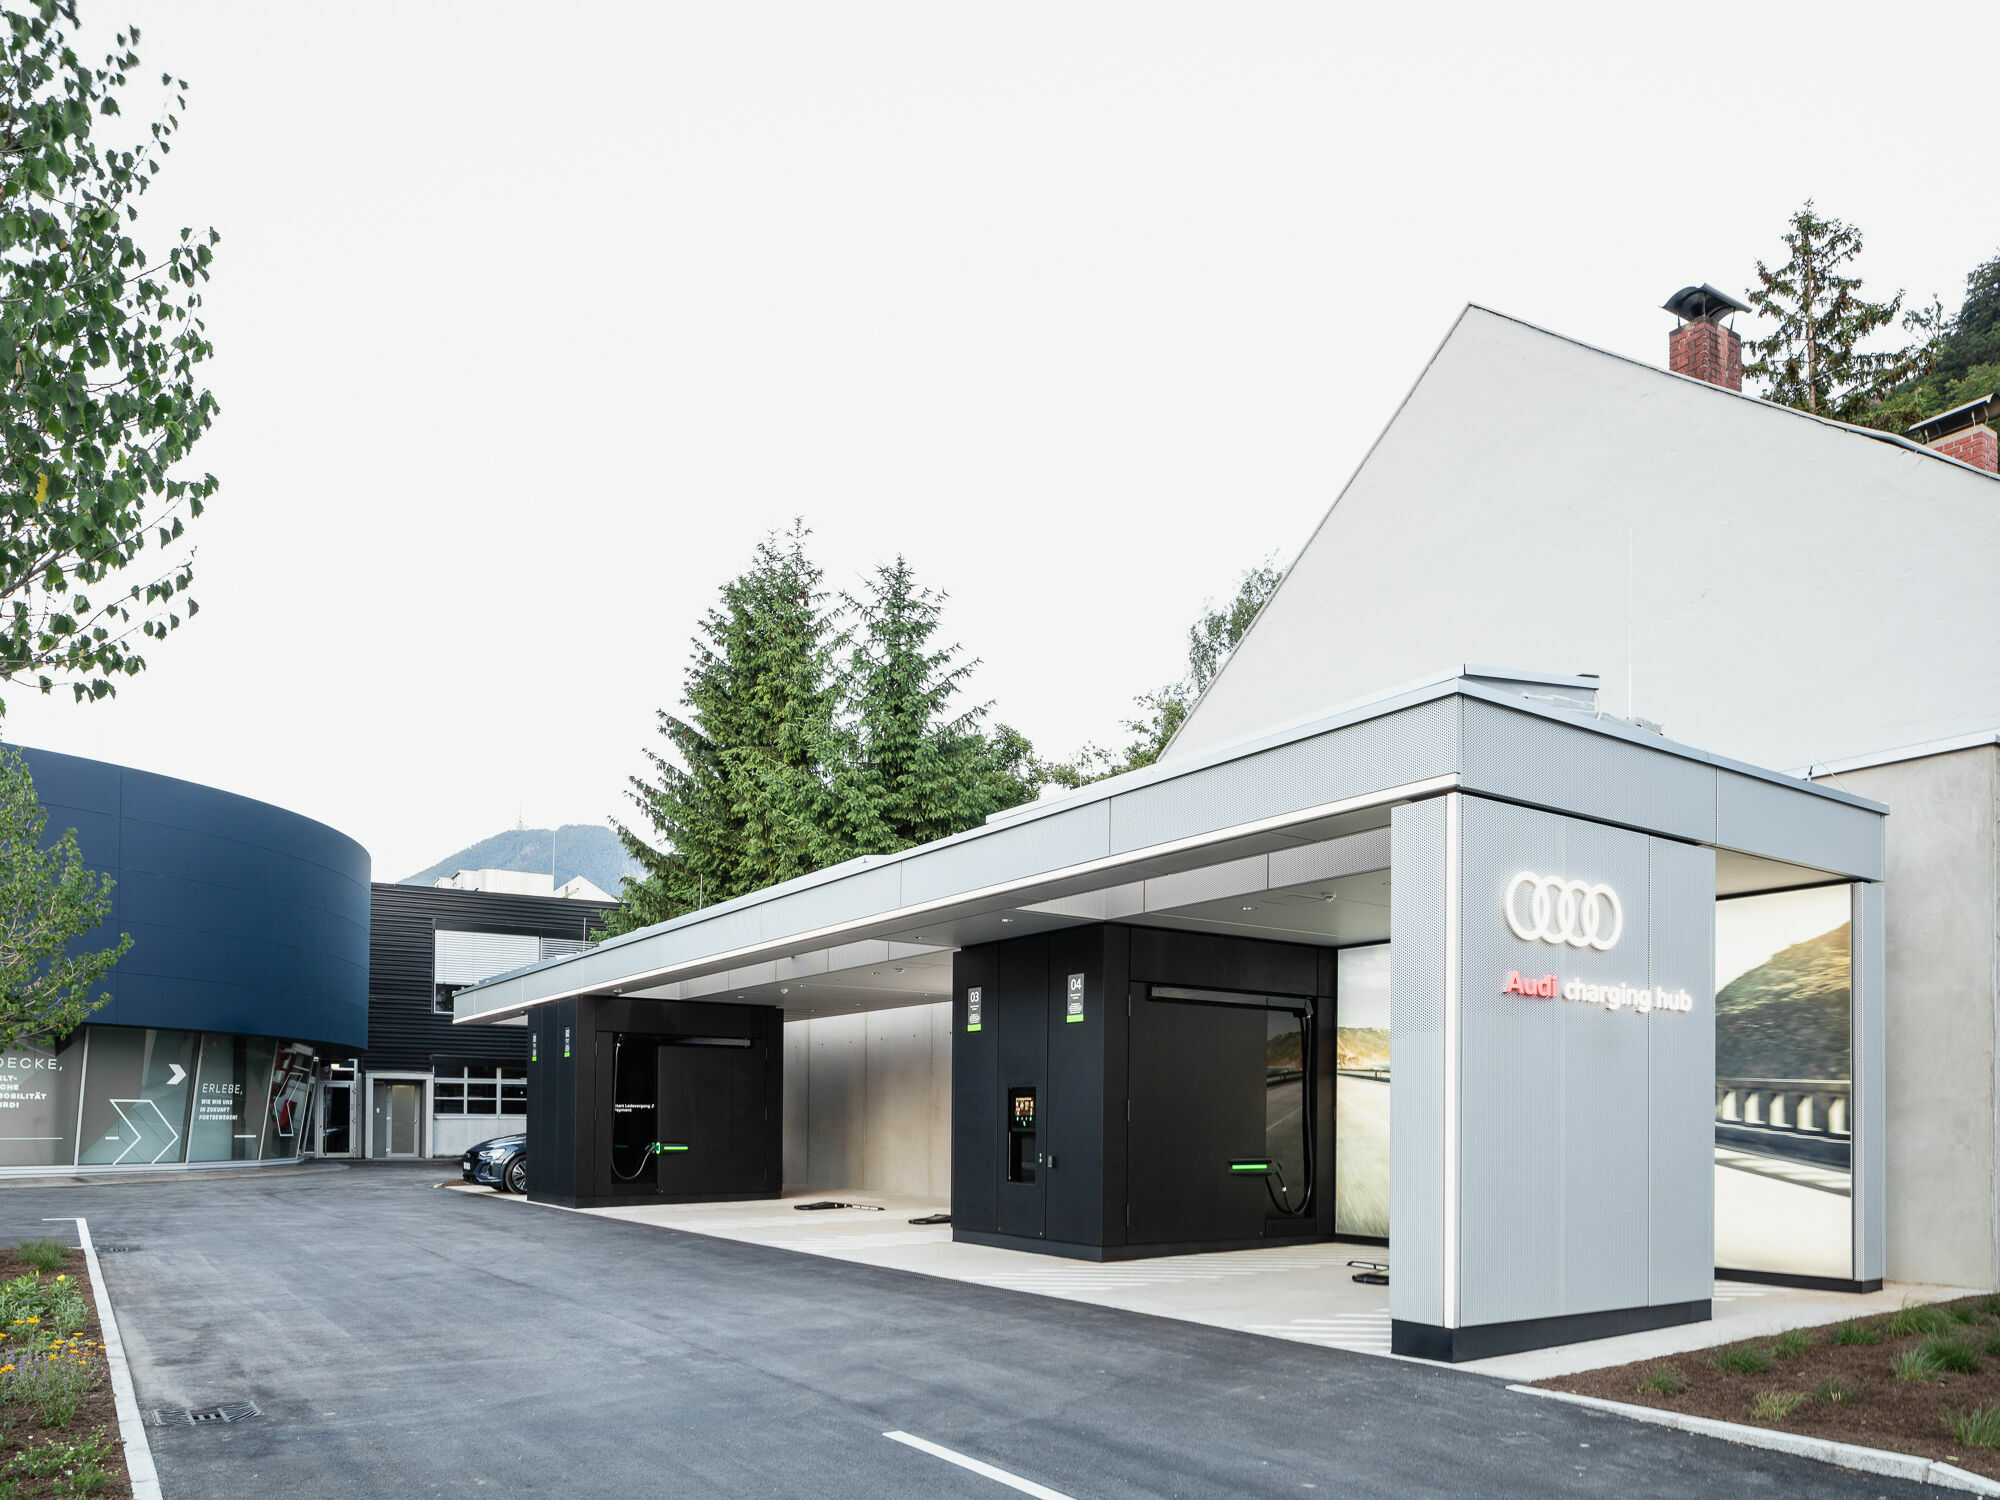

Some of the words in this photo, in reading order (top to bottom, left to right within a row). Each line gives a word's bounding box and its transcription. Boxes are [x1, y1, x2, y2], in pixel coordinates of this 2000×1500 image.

[1071, 978, 1082, 991] 04
[1506, 969, 1559, 998] Audi
[1562, 977, 1651, 1012] charging
[1655, 985, 1693, 1012] hub
[970, 991, 980, 1003] 03
[202, 1083, 243, 1095] ERLEBE,
